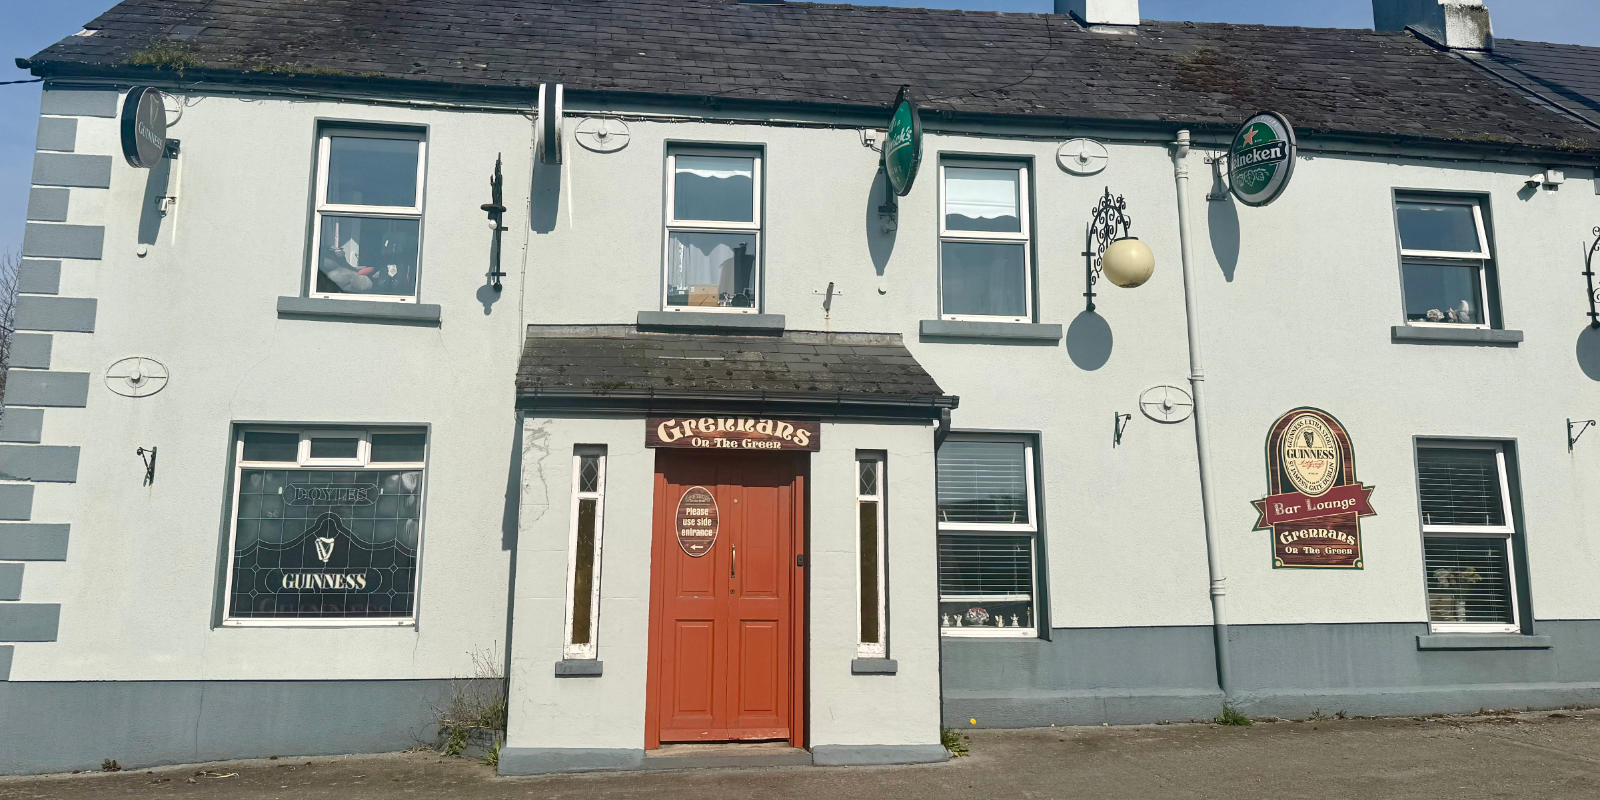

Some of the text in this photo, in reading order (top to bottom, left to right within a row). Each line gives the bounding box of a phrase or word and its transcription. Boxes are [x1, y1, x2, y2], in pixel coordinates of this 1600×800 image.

[1231, 146, 1282, 170] eineken
[657, 417, 812, 446] Grennans
[1287, 419, 1334, 449] GUINNESS EXTRA STOUT
[691, 437, 781, 449] On The Green
[1287, 448, 1335, 460] GUINNESS
[1308, 483, 1324, 491] GATE
[1322, 461, 1335, 485] DUBLIN
[686, 507, 709, 516] Please
[1274, 498, 1356, 516] Bar Lounge
[682, 517, 712, 526] use side
[681, 528, 713, 537] entrance
[1280, 528, 1356, 545] Grennans
[1285, 546, 1353, 555] On The Green
[282, 573, 367, 589] GUINNESS
